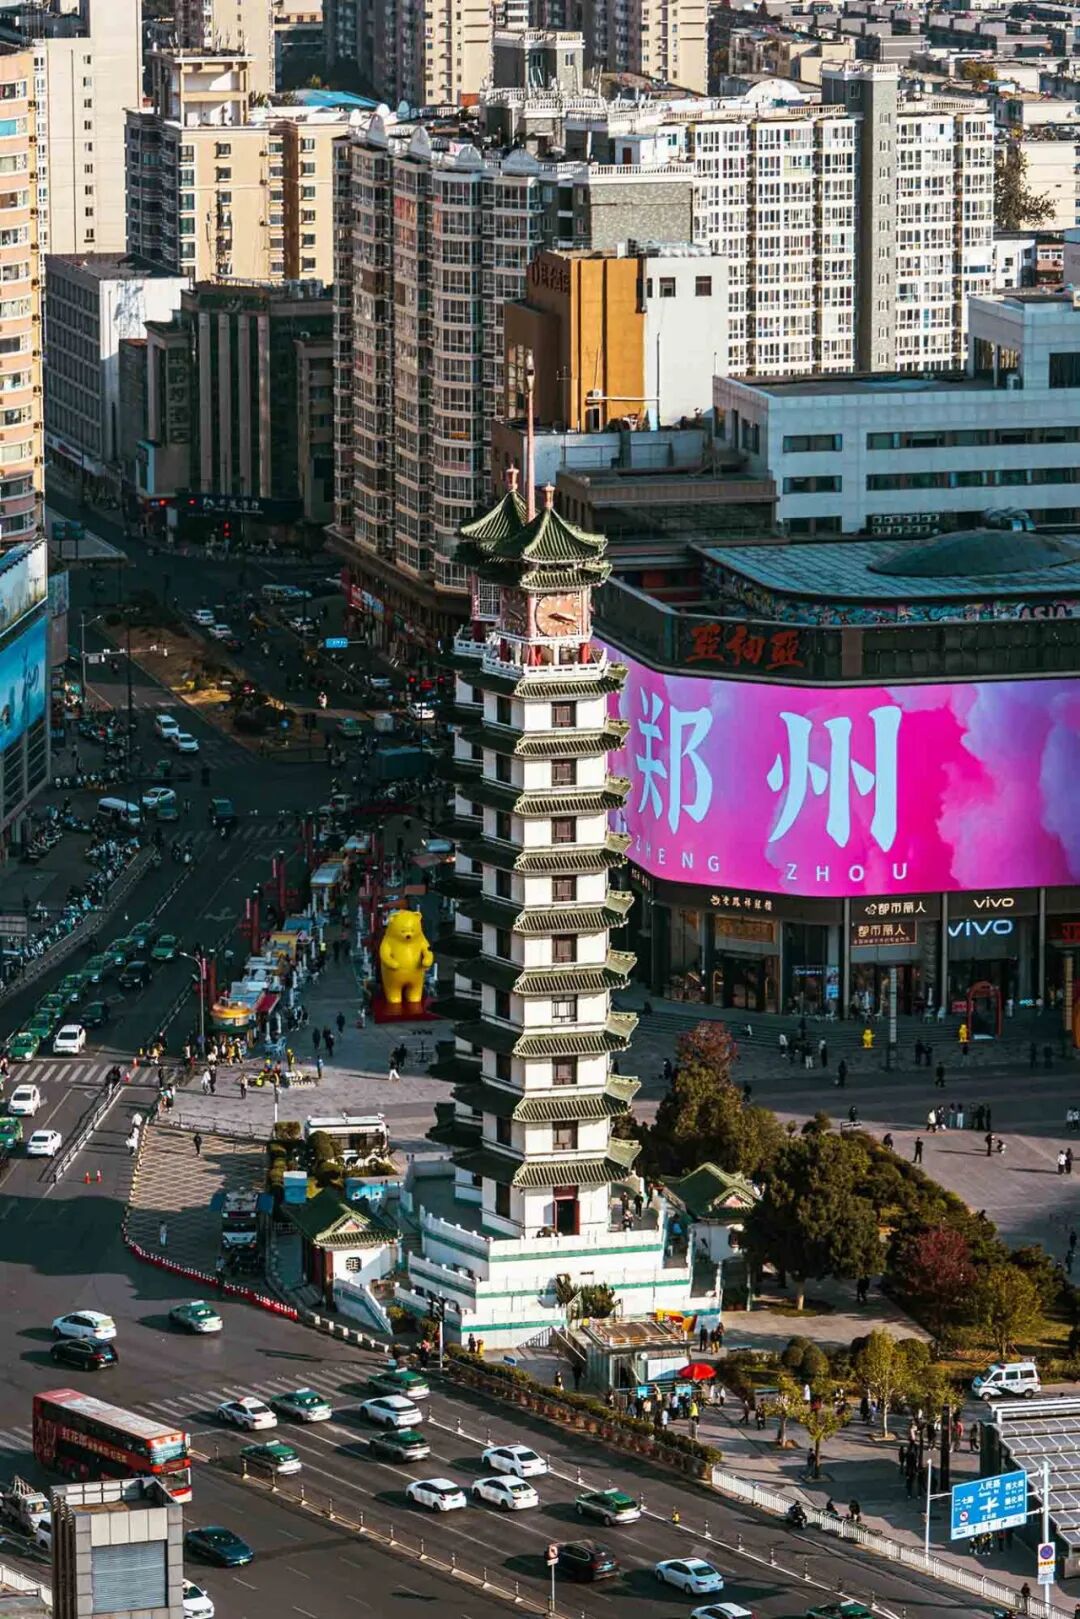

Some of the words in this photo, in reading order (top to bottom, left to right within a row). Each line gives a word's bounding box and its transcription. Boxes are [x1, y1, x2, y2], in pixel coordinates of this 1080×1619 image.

[635, 686, 903, 853] 郑州
[785, 862, 908, 883] ZHOU
[878, 901, 926, 915] 都市丽人
[973, 896, 1015, 909] vivo
[857, 923, 906, 938] 都市丽人
[947, 918, 1014, 937] vivo
